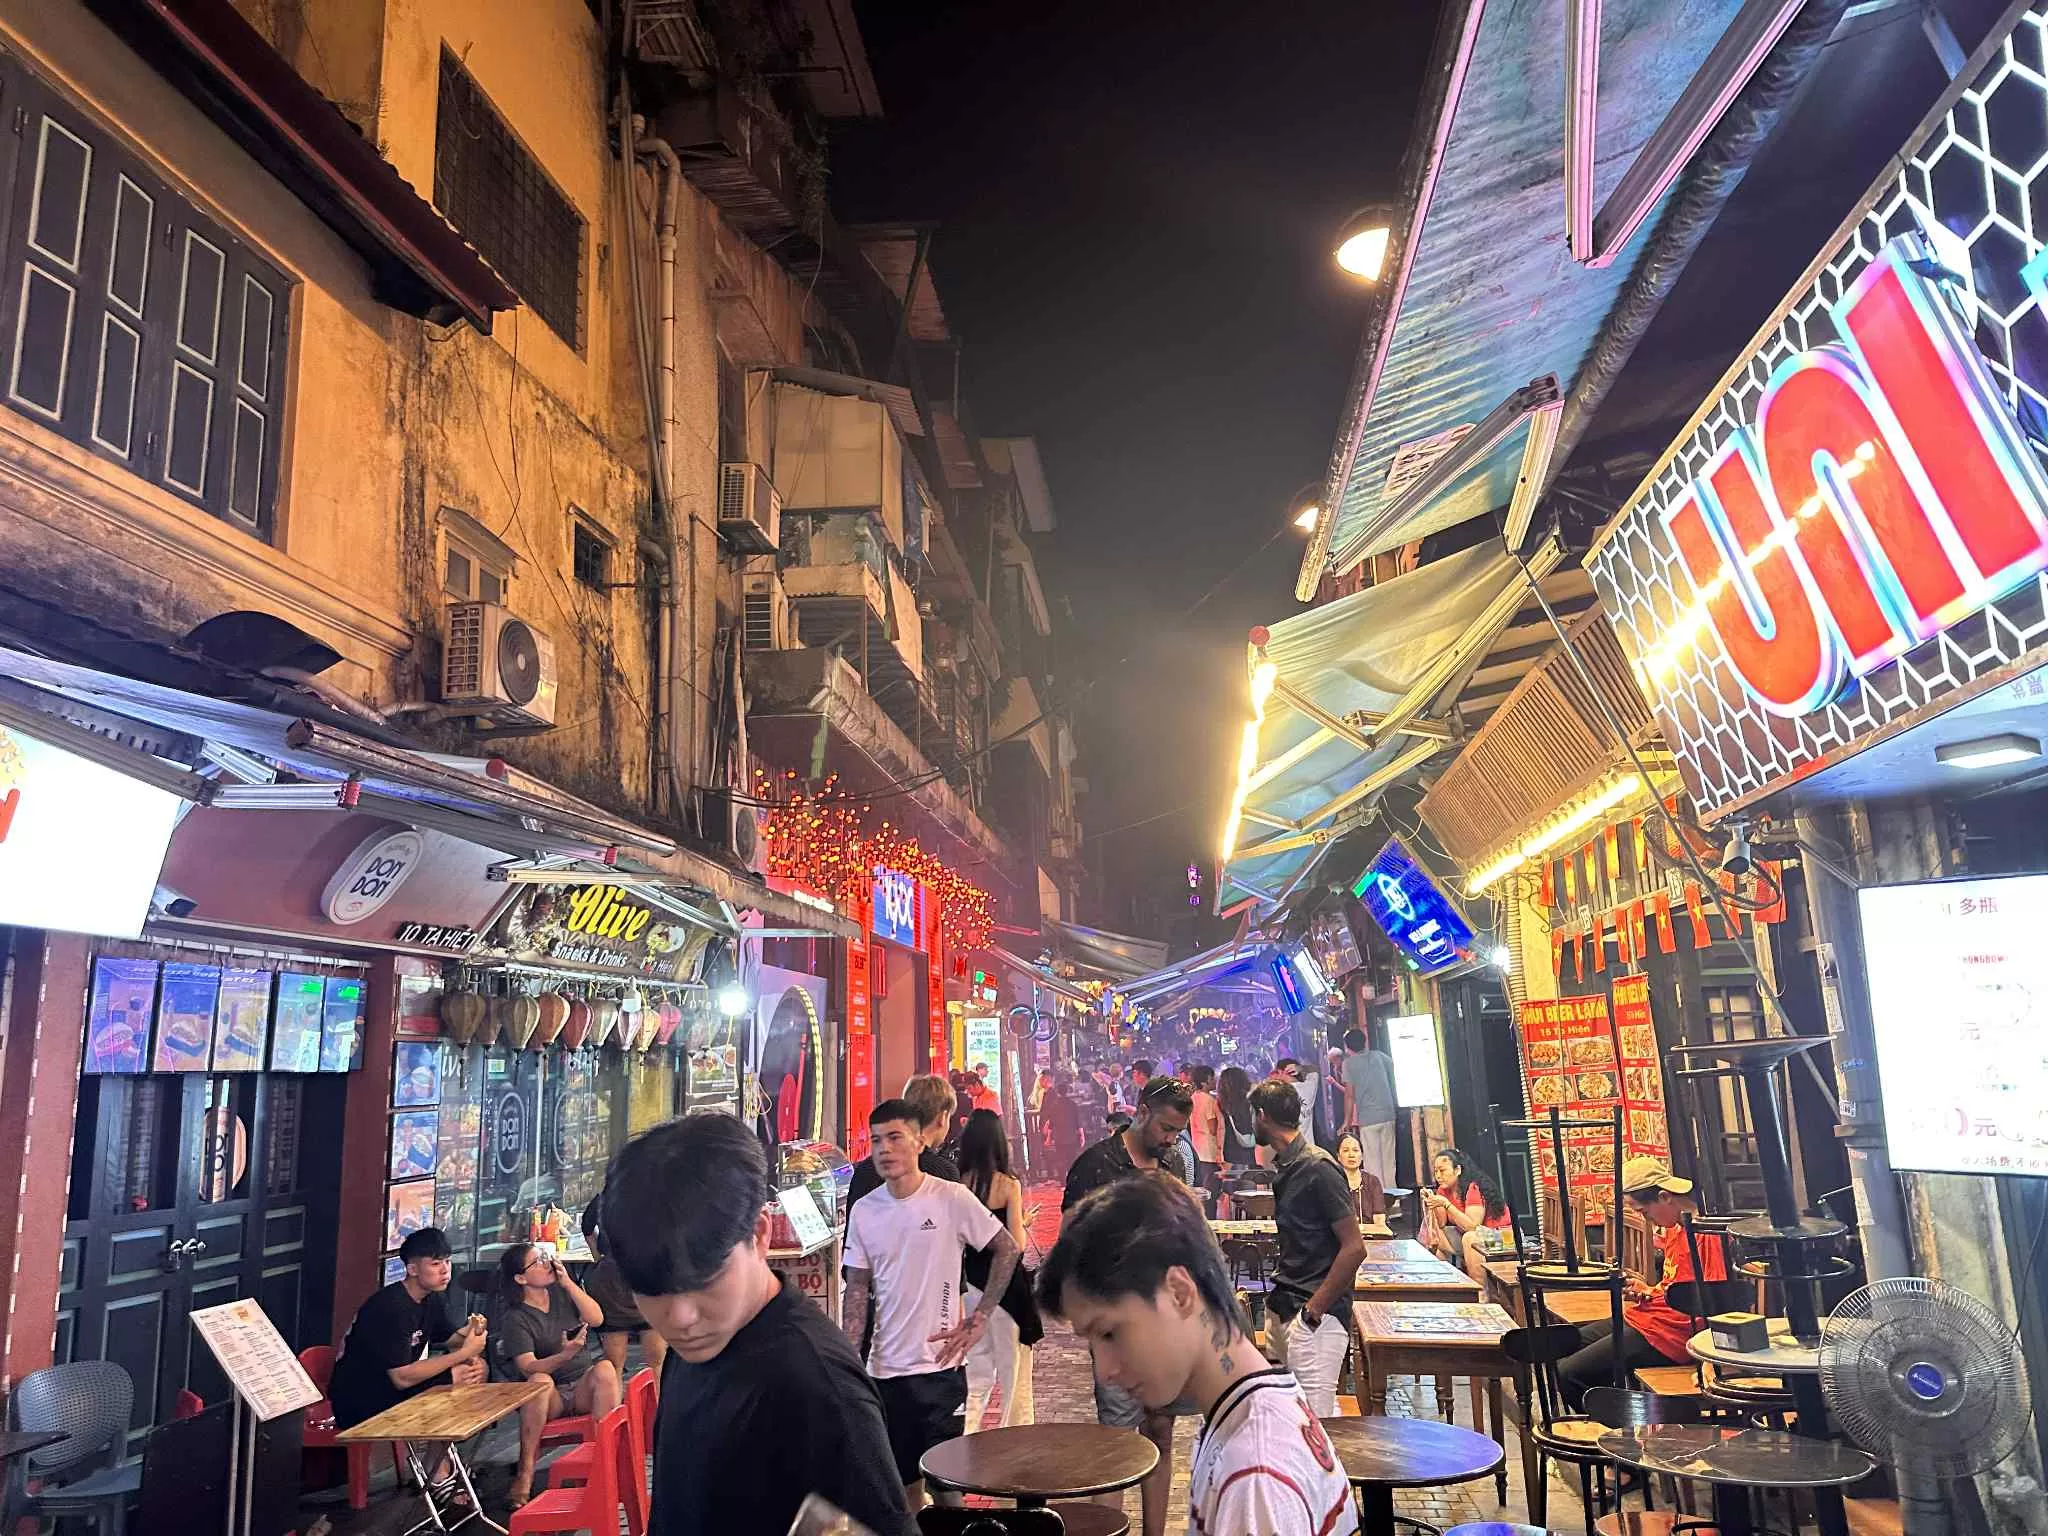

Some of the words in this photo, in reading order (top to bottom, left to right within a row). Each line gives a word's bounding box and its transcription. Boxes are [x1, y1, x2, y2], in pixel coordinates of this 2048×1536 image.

[365, 857, 407, 878] DON
[350, 876, 391, 897] DON
[568, 884, 651, 941] Olive
[399, 924, 421, 942] 10
[552, 941, 590, 962] Snacks
[590, 947, 600, 963] &
[598, 949, 628, 967] Drinks
